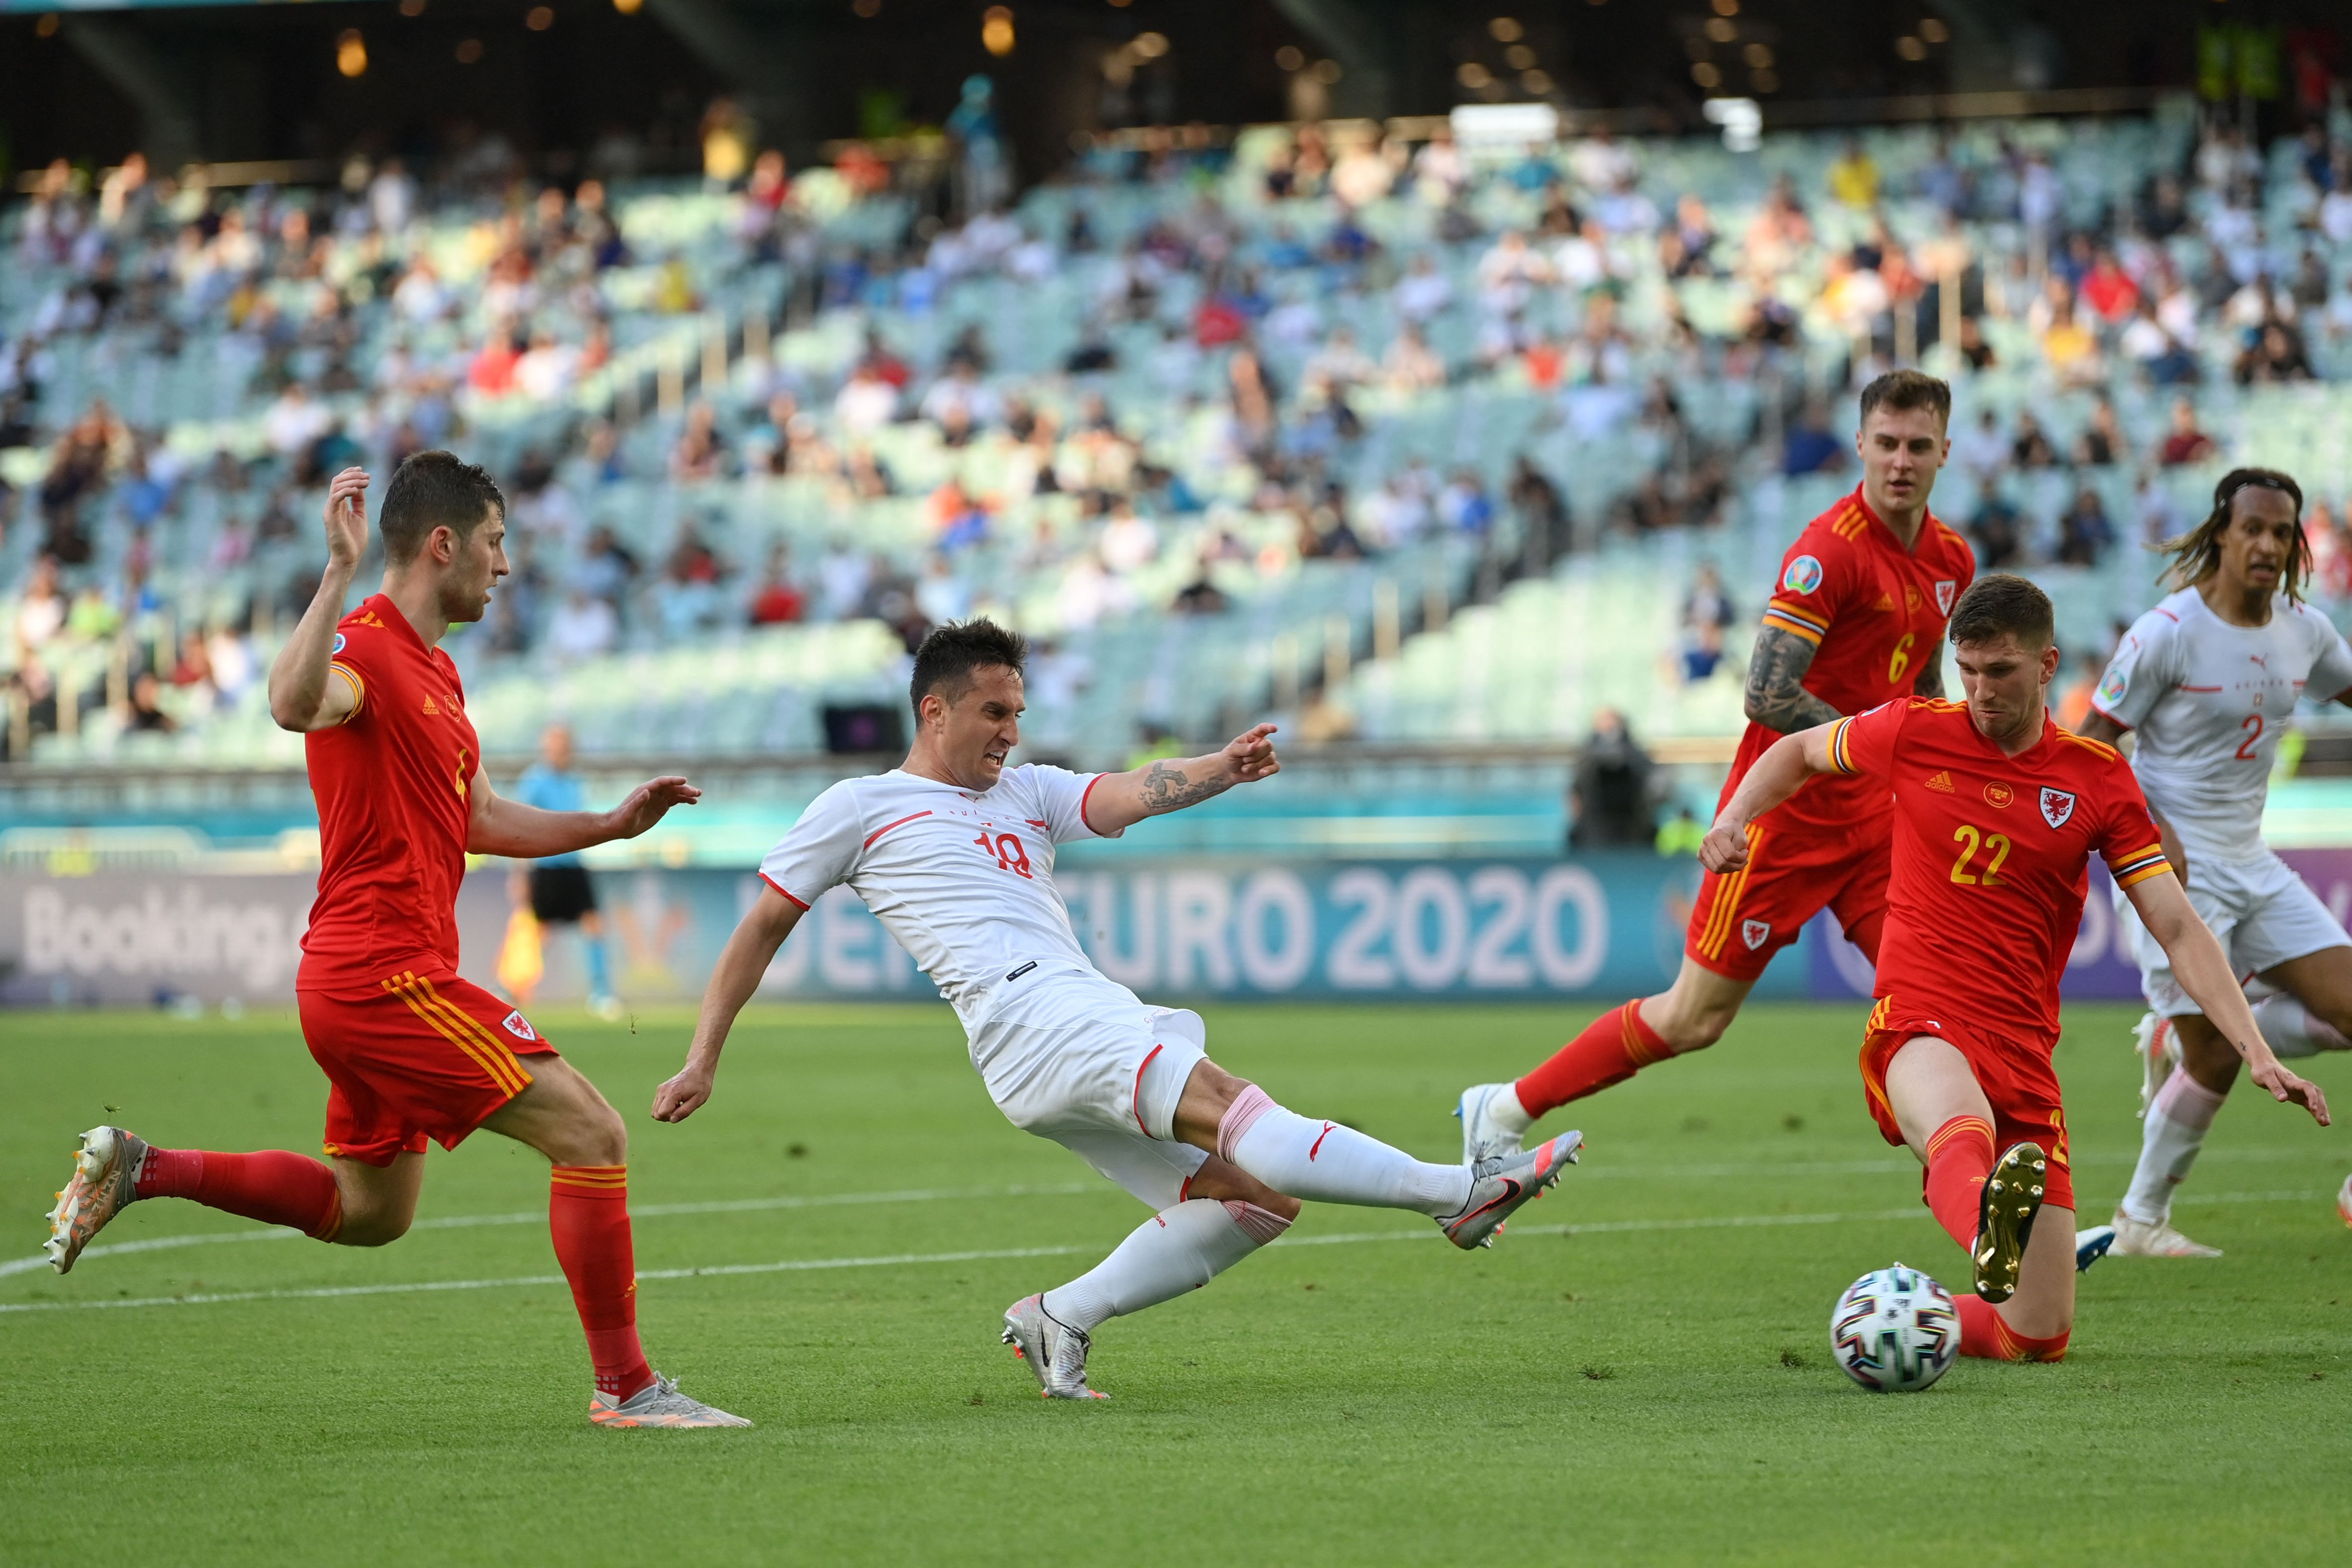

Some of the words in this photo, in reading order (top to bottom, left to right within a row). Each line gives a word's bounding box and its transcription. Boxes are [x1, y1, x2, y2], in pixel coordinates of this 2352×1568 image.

[1889, 632, 1915, 684] 6
[2235, 713, 2264, 759] 2
[1925, 781, 1955, 793] adidas
[973, 832, 1033, 879] 10
[1950, 824, 2011, 886] 22
[1325, 863, 1611, 992] 2020
